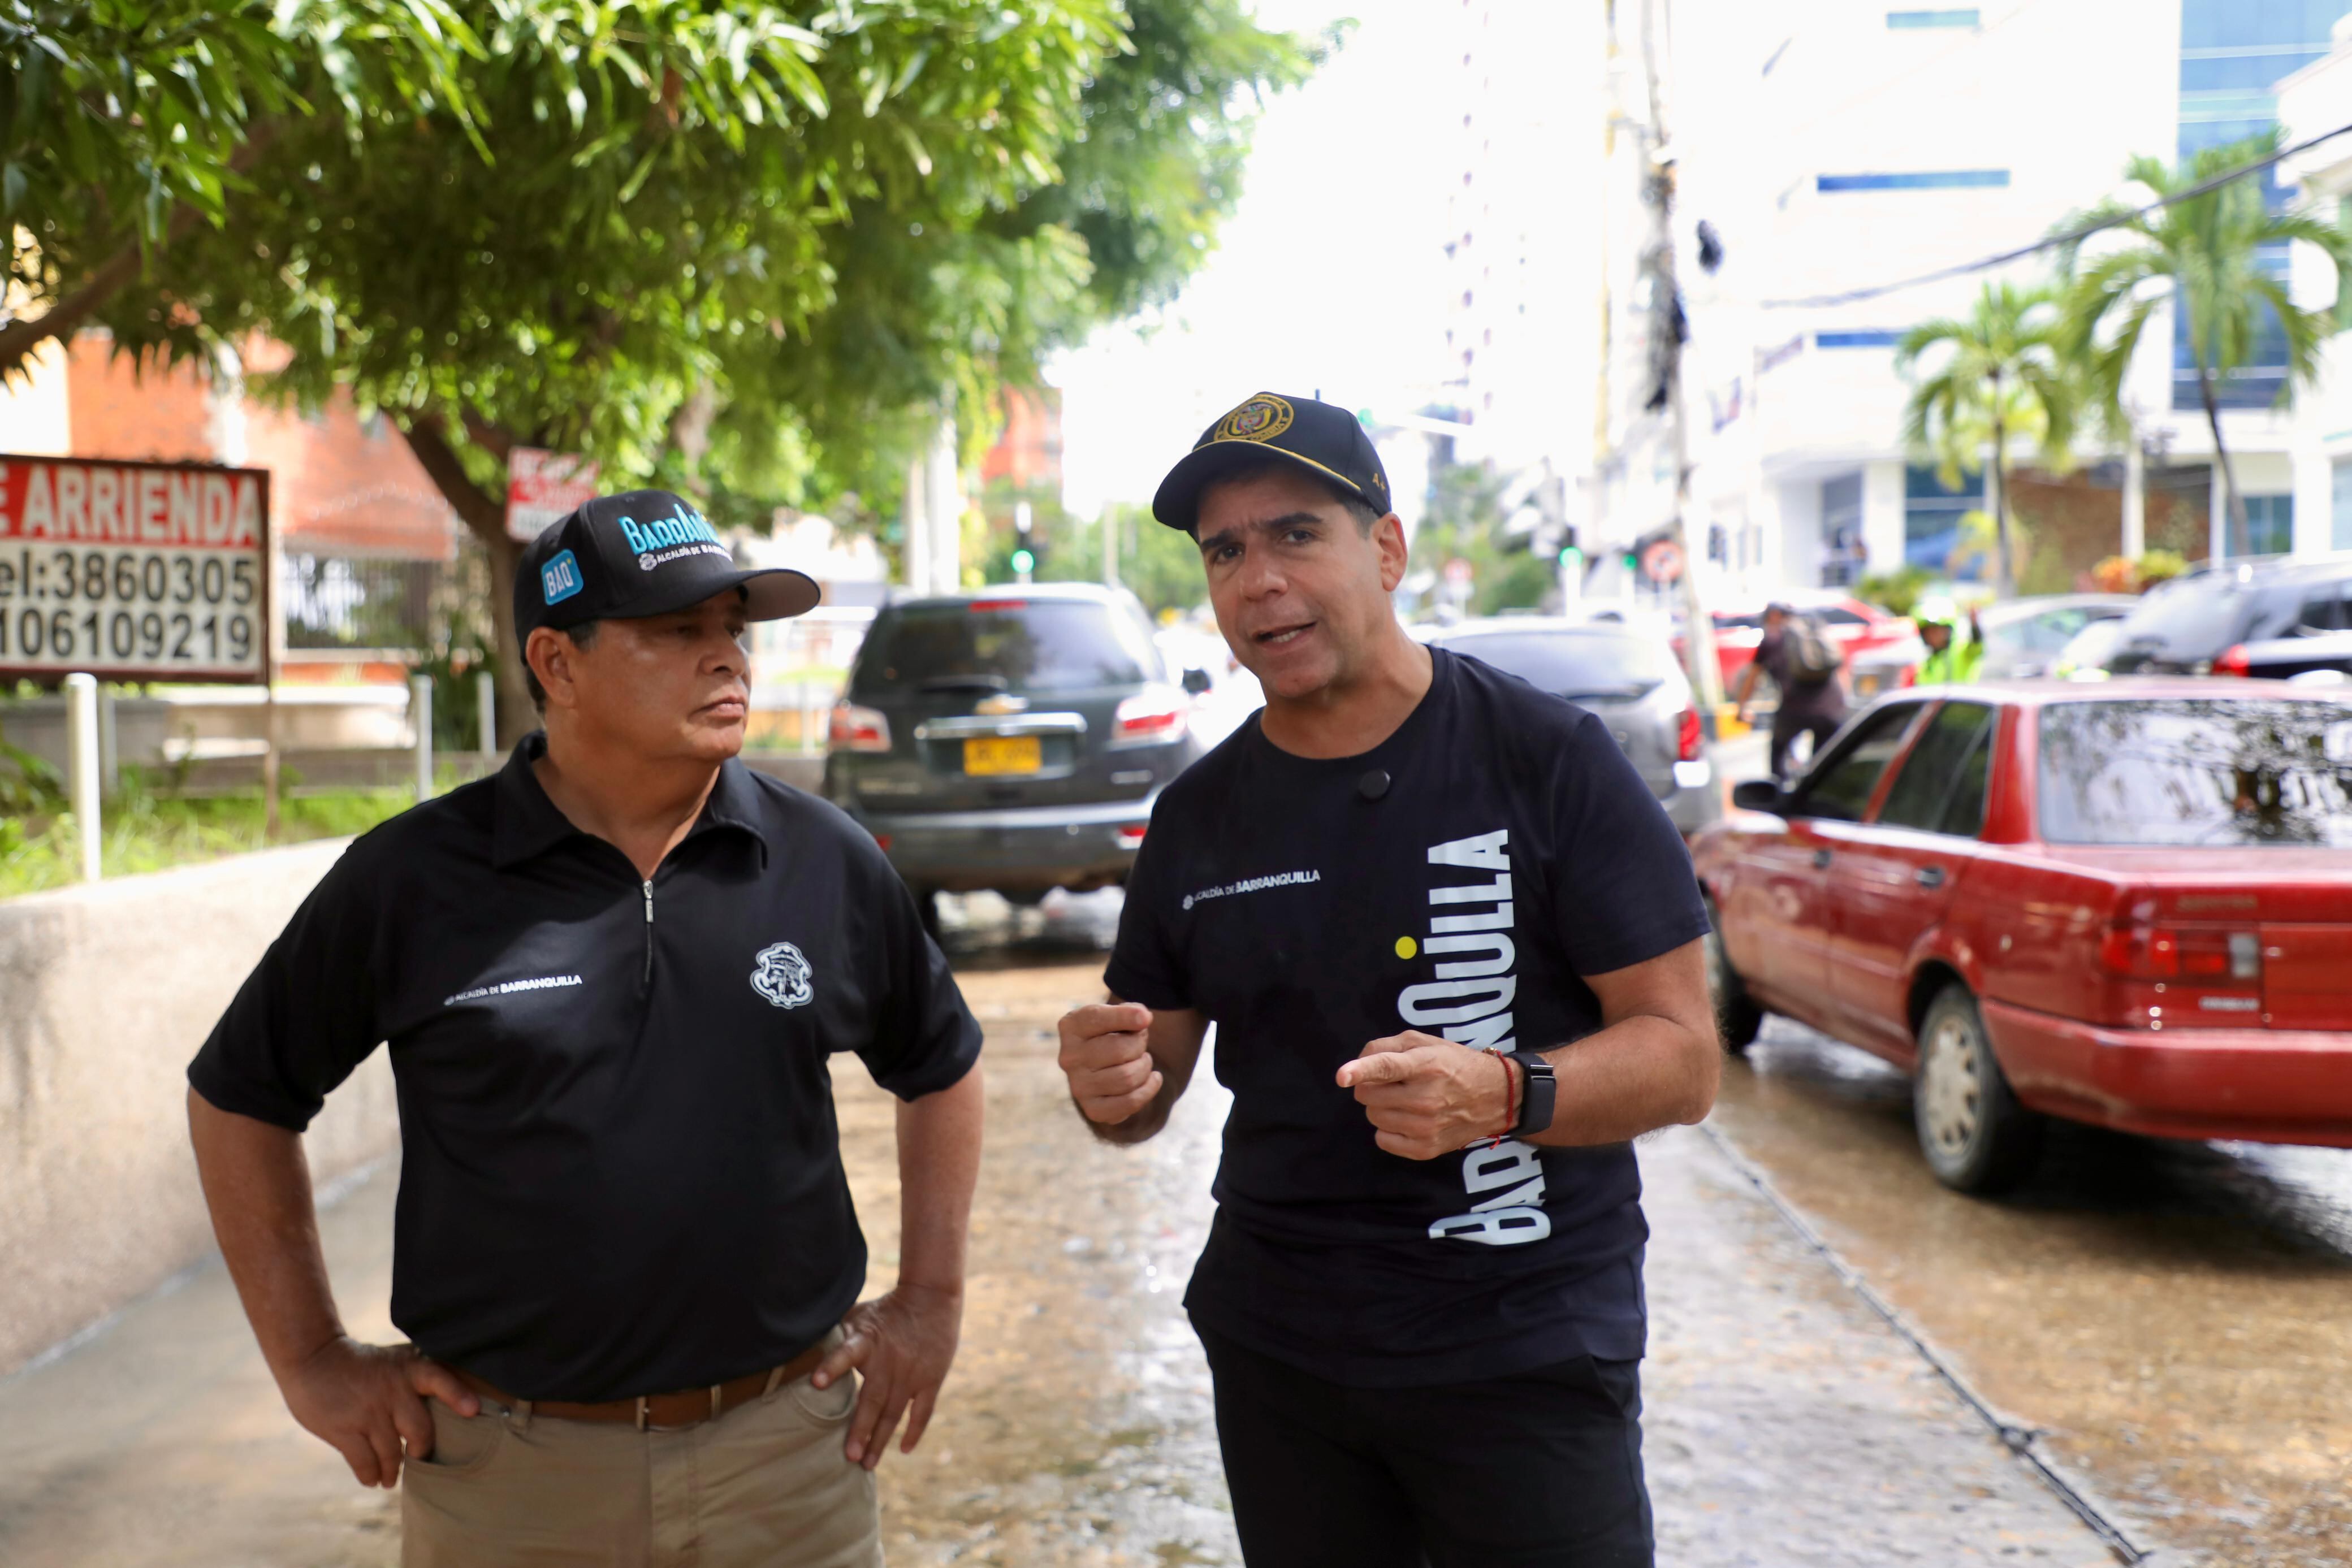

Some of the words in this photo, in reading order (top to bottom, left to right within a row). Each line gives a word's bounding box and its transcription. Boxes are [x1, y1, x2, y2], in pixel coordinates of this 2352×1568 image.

[23, 465, 260, 545] ARRIENDA
[690, 546, 701, 555] DE
[0, 549, 254, 606] el:3860305
[1225, 885, 1236, 895] DE
[455, 987, 488, 1002] ALCALDÍA
[488, 985, 500, 995] DE
[500, 974, 582, 994] BARRANQUILLA
